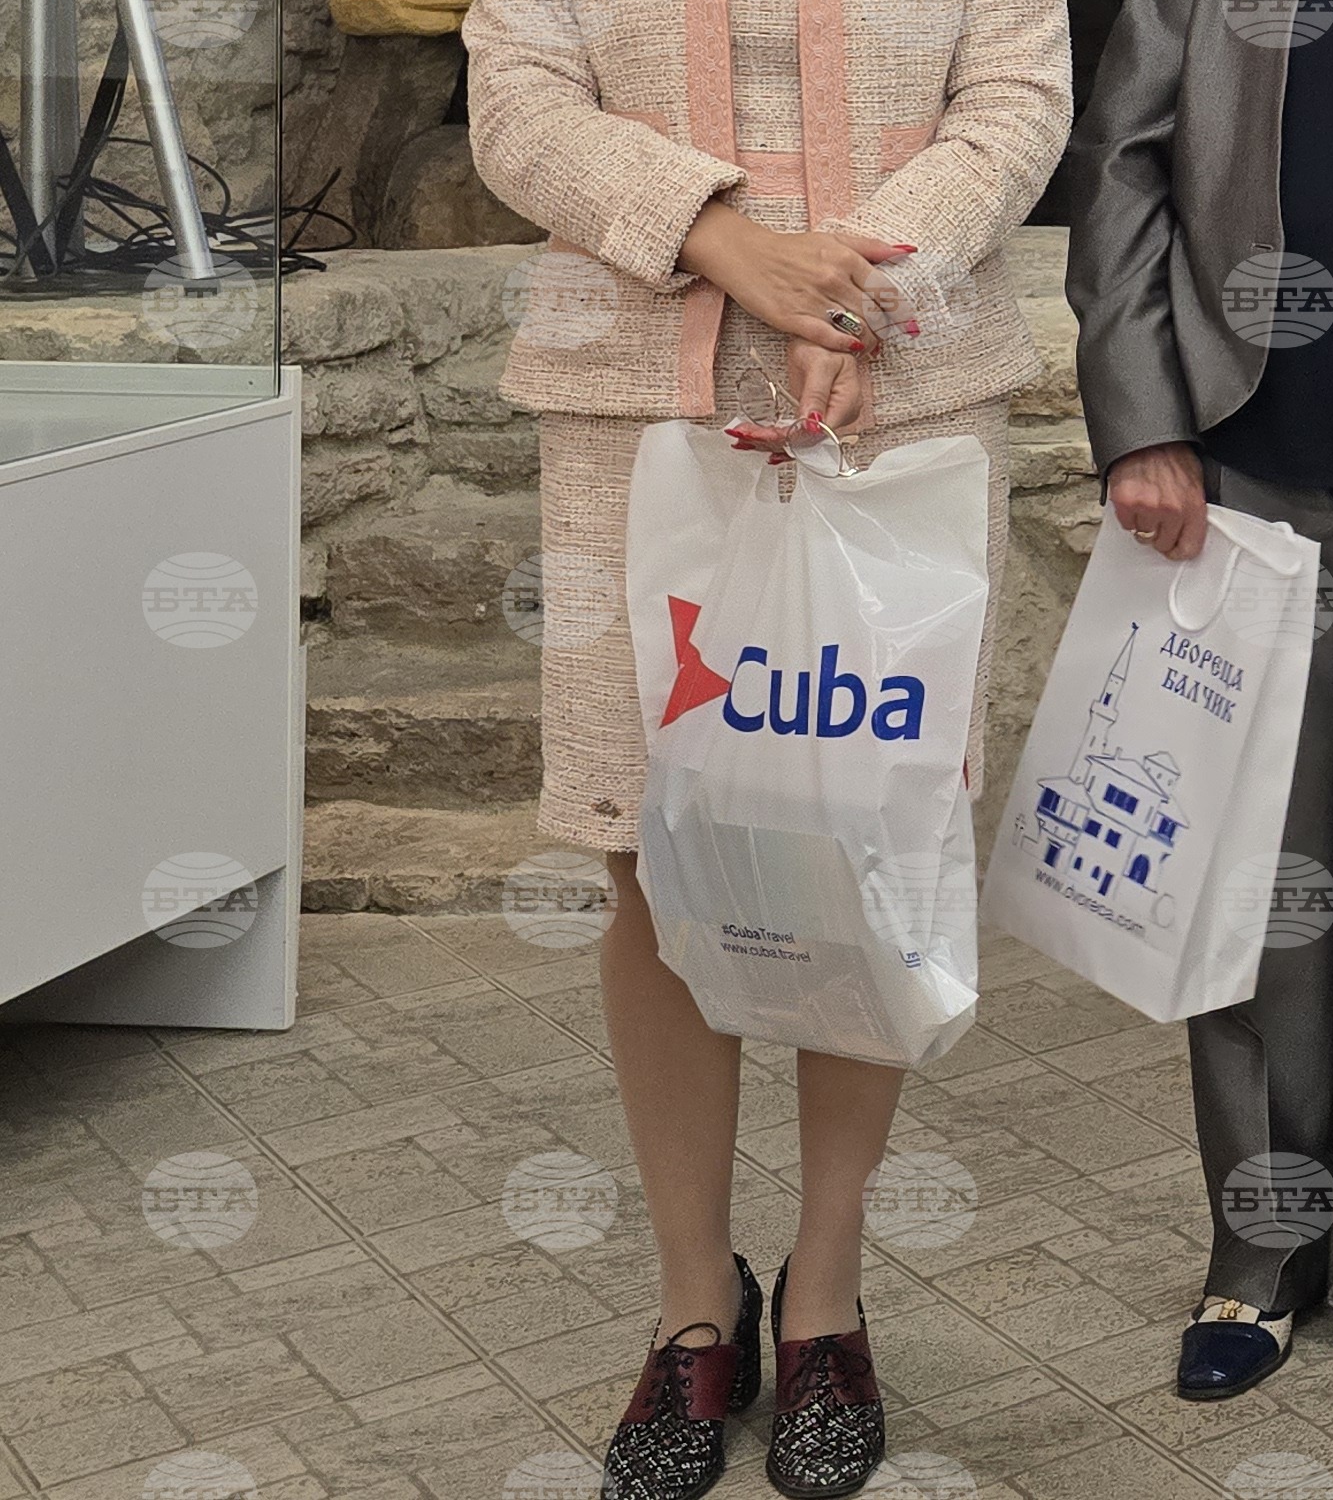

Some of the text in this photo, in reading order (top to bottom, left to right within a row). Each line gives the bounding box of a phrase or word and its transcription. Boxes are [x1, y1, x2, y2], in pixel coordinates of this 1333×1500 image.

[1160, 631, 1244, 692] ДВОРЕЦА
[722, 644, 925, 741] Cuba
[1161, 667, 1237, 723] БАЛЧИК
